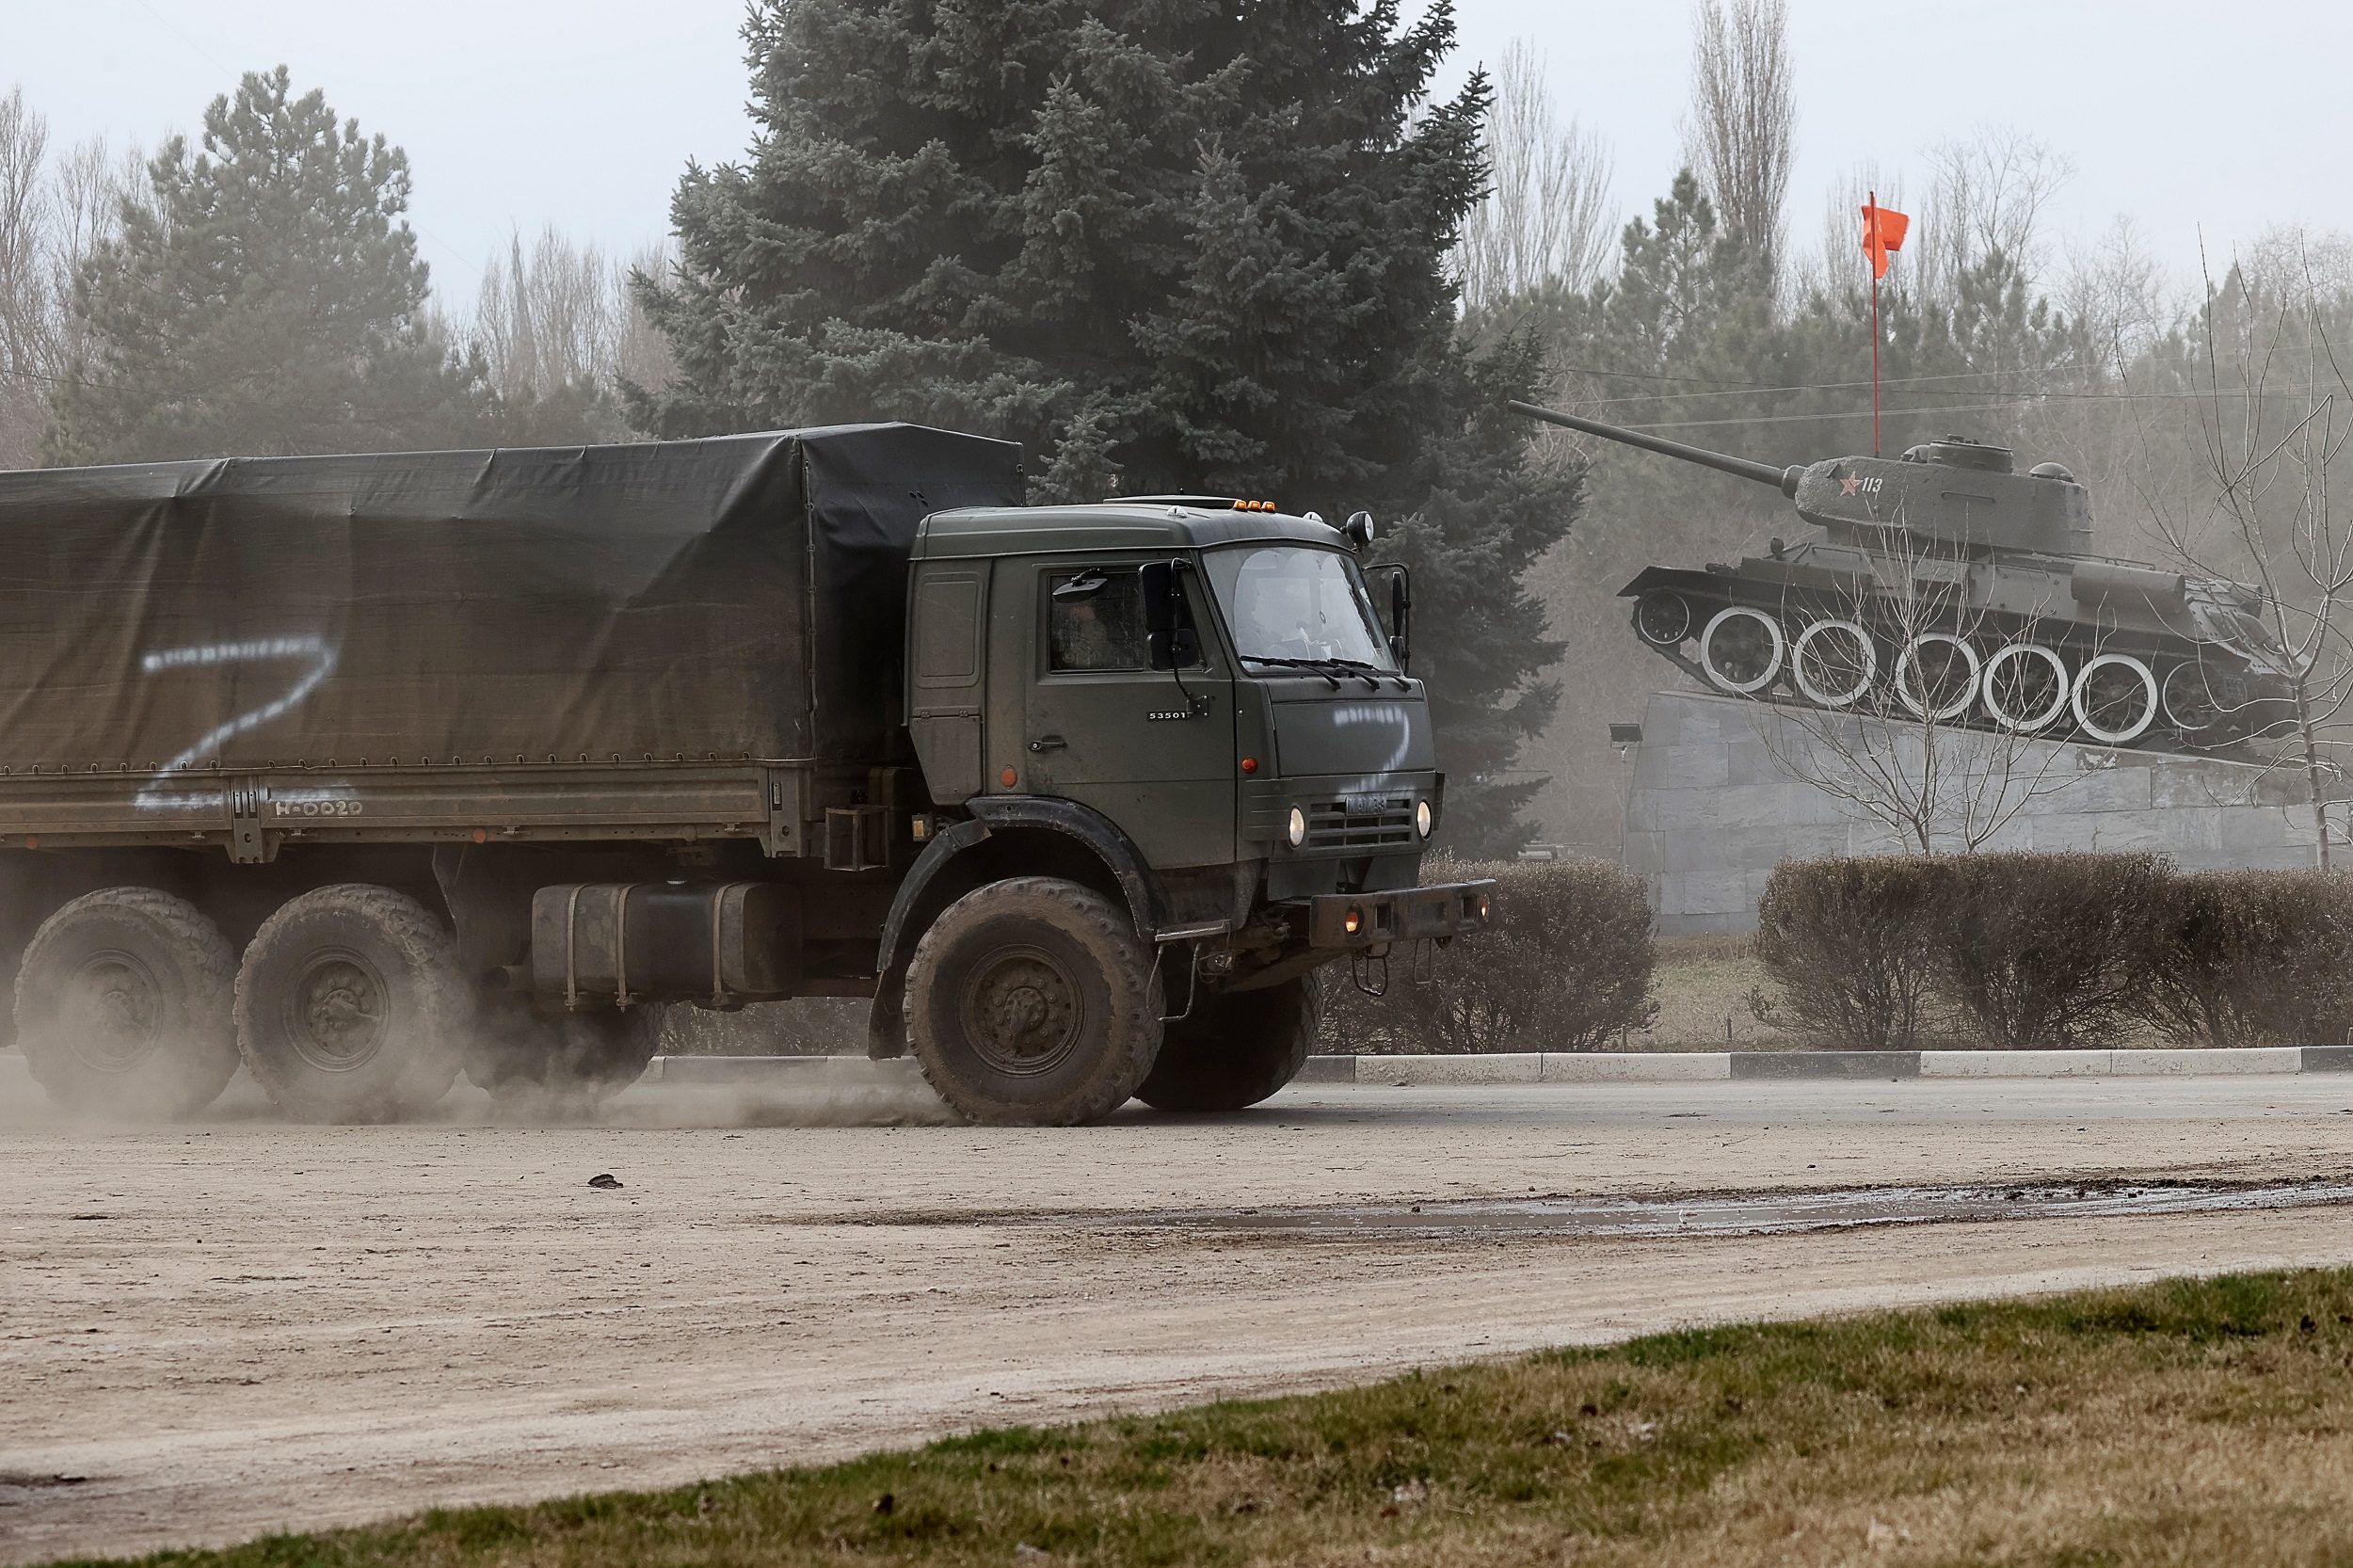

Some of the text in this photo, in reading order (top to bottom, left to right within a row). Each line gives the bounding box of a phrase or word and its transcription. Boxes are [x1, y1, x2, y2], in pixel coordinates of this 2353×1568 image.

[1862, 476, 1883, 493] 113
[133, 634, 357, 810] Z
[1334, 707, 1416, 801] Z
